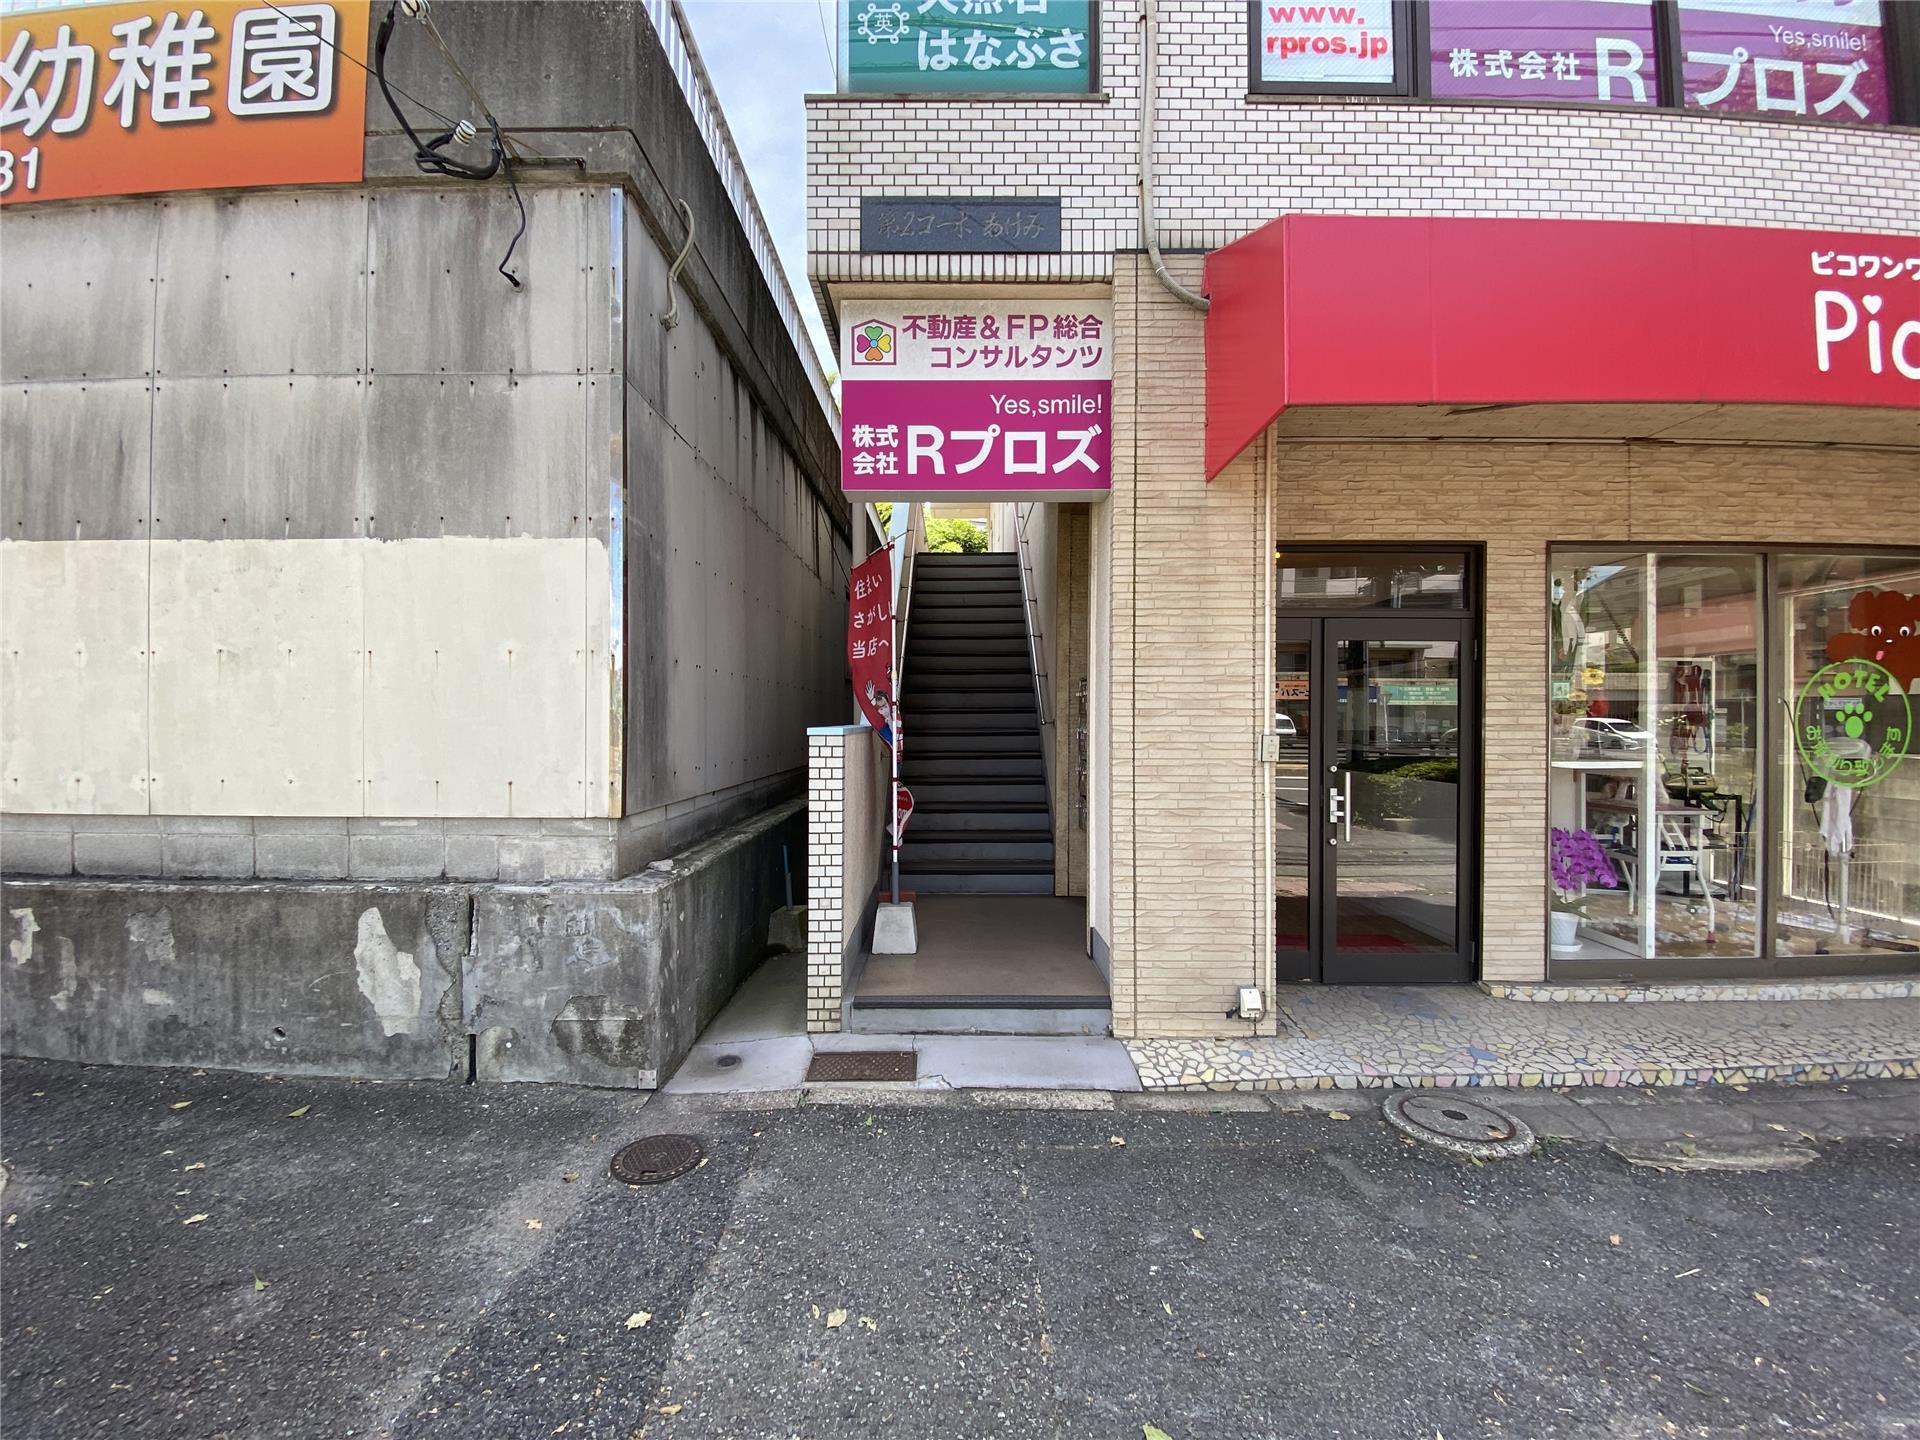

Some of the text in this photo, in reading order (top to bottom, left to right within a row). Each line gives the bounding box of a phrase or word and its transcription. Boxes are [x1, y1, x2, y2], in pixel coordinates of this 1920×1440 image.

[874, 13, 894, 34] 英
[1269, 6, 1365, 25] www.
[917, 26, 1085, 71] はなぶさ
[1266, 31, 1389, 60] rpros.jp
[1768, 24, 1867, 52] Yes,smile!
[0, 3, 336, 137] 幼稚園
[1449, 47, 1582, 82] 株式会社
[930, 344, 1103, 370] コンサルタンツ
[990, 394, 1102, 417] Yes,smile!
[906, 423, 1103, 475] Rプロズ
[852, 636, 889, 659] 当店へ
[1817, 669, 1891, 703] HOTEL
